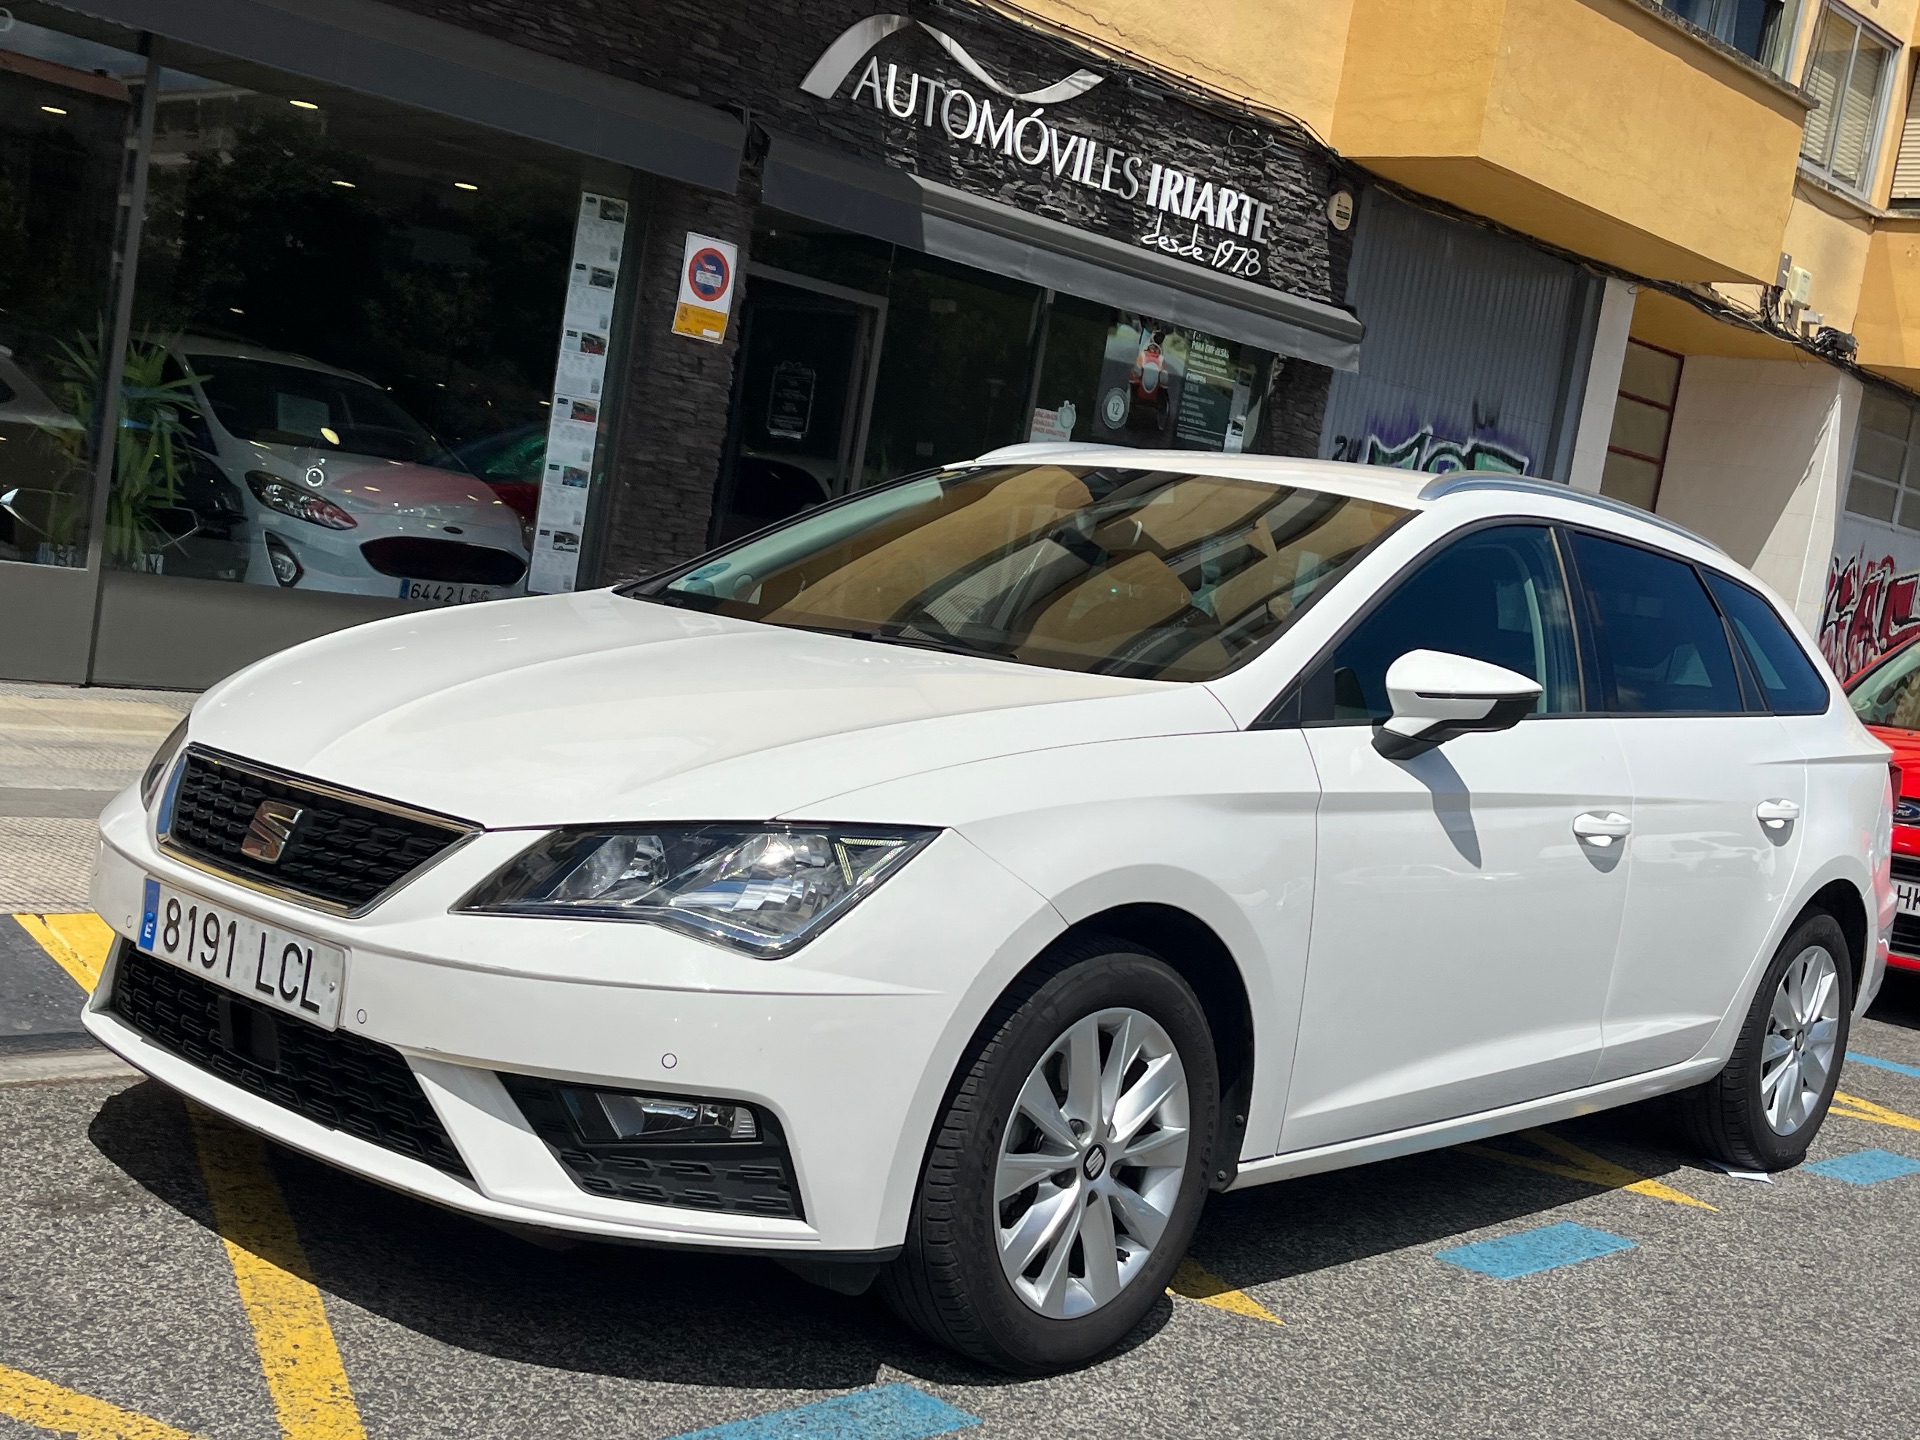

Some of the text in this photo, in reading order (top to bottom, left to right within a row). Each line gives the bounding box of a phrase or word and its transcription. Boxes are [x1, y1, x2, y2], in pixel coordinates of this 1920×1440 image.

[850, 55, 1274, 245] AUTOMÓVILES IRIARTE
[1142, 212, 1262, 277] desde 1978
[410, 583, 454, 603] 6442
[144, 922, 154, 939] E
[163, 897, 320, 1015] 8191 LCL
